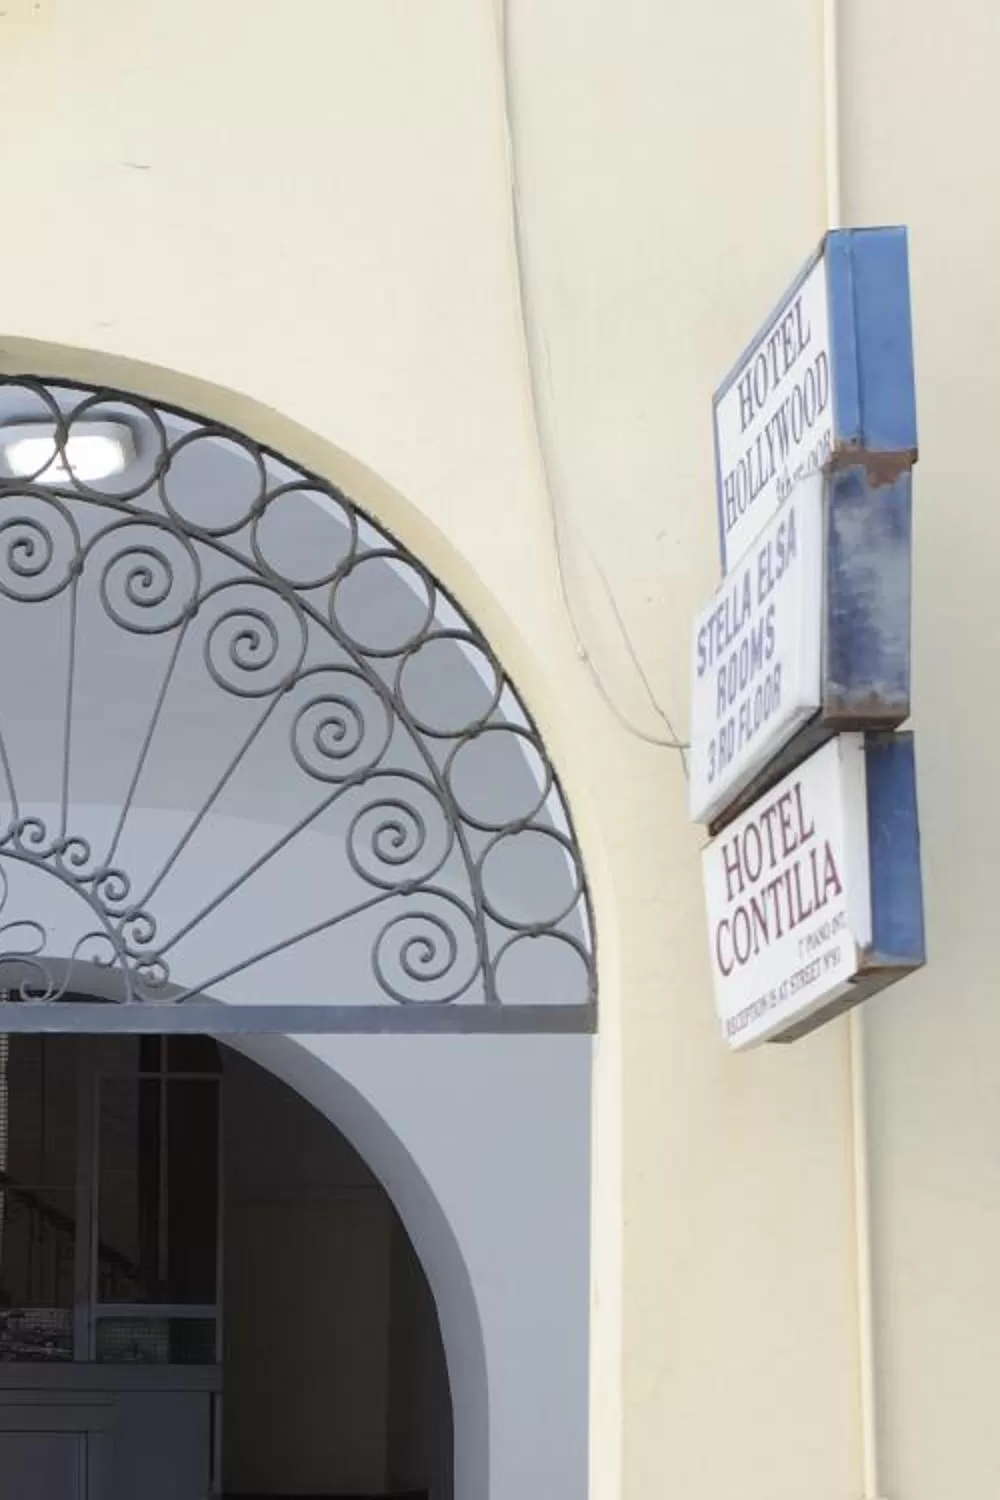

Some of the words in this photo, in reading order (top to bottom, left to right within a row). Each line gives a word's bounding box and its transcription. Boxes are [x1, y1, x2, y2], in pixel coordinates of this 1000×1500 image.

[737, 295, 811, 433] HOTEL
[723, 351, 829, 532] HOLLYWOOD
[697, 566, 751, 677] STELLA
[757, 505, 797, 604] ELSA
[717, 603, 775, 719] ROOMS
[738, 662, 781, 751] FLOOR
[721, 781, 815, 903] HOTEL
[716, 840, 843, 977] CONTILIA
[789, 957, 821, 995] STREET
